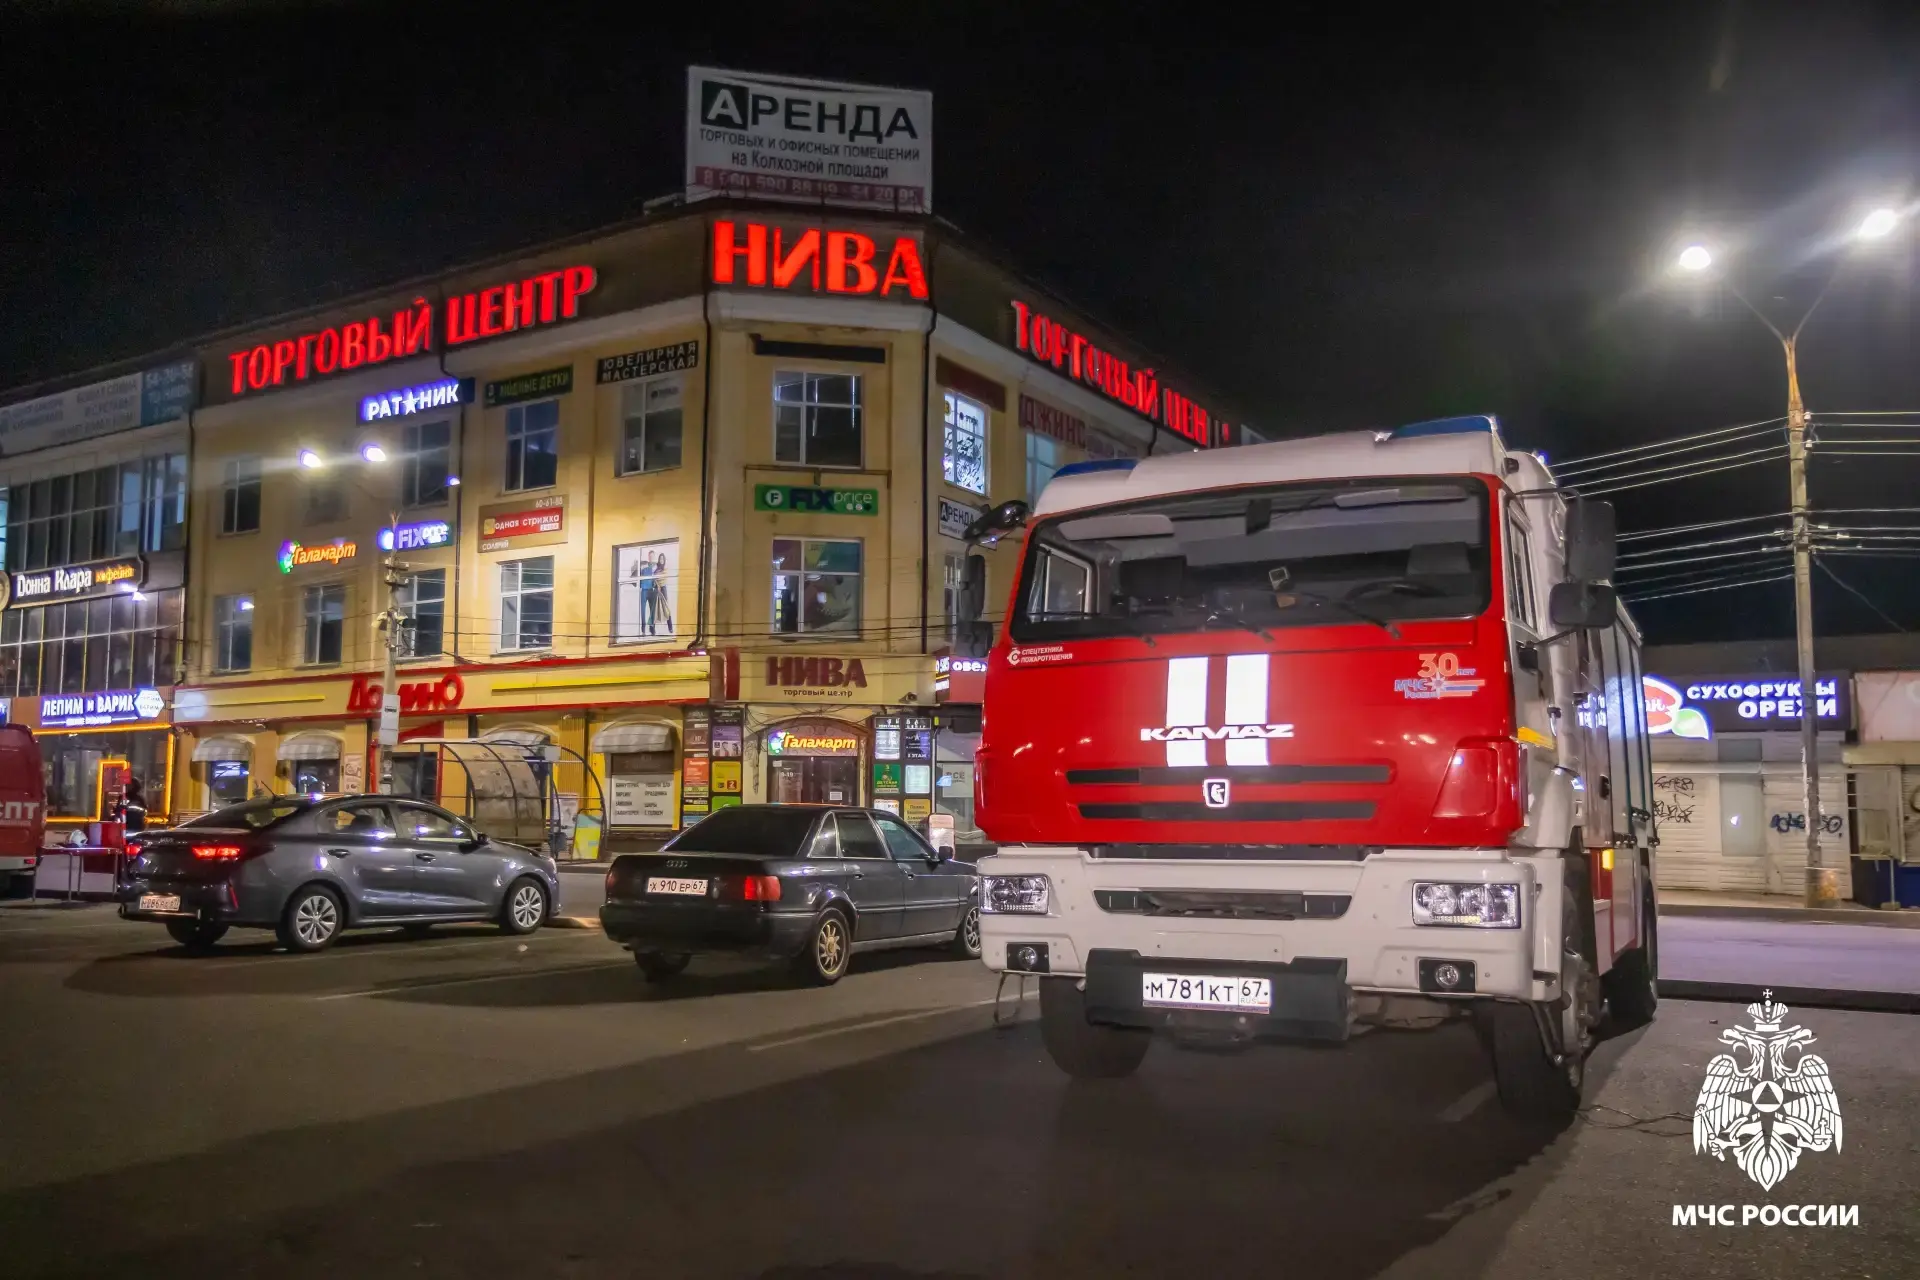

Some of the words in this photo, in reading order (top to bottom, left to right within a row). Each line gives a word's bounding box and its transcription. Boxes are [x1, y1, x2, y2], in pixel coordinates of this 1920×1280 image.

[704, 86, 918, 144] АРЕНДА
[701, 128, 764, 149] ТОРГОВЫХ
[768, 139, 776, 149] И
[779, 139, 840, 157] ОФИСНЫХ
[844, 144, 920, 161] ПОМЕЩЕНИЙ
[732, 151, 748, 166] на
[752, 152, 823, 174] Колхозной
[828, 161, 889, 179] площади
[714, 220, 930, 299] НИВА
[229, 296, 432, 394] ТОРГОВЫЙ
[448, 265, 597, 345] ЦЕНТР
[602, 355, 695, 381] МАСТЕРСКАЯ
[603, 342, 696, 370] ЮВЕЛИРНАЯ
[1011, 299, 1158, 420] ТОРГОВЫЙ
[539, 372, 568, 391] ДЕТКИ
[294, 543, 357, 565] Галамарт
[765, 655, 868, 688] НИВА
[1417, 652, 1459, 678] 30
[783, 688, 825, 697] торговый
[1394, 678, 1428, 692] МЧС
[1686, 679, 1836, 700] СУХОФРУКЫ
[42, 698, 84, 717] ЛЕПИМ
[783, 734, 856, 752] Галамарт
[1140, 723, 1295, 741] KAMAZ
[1150, 977, 1234, 1002] М781КТ
[1241, 980, 1263, 997] 67
